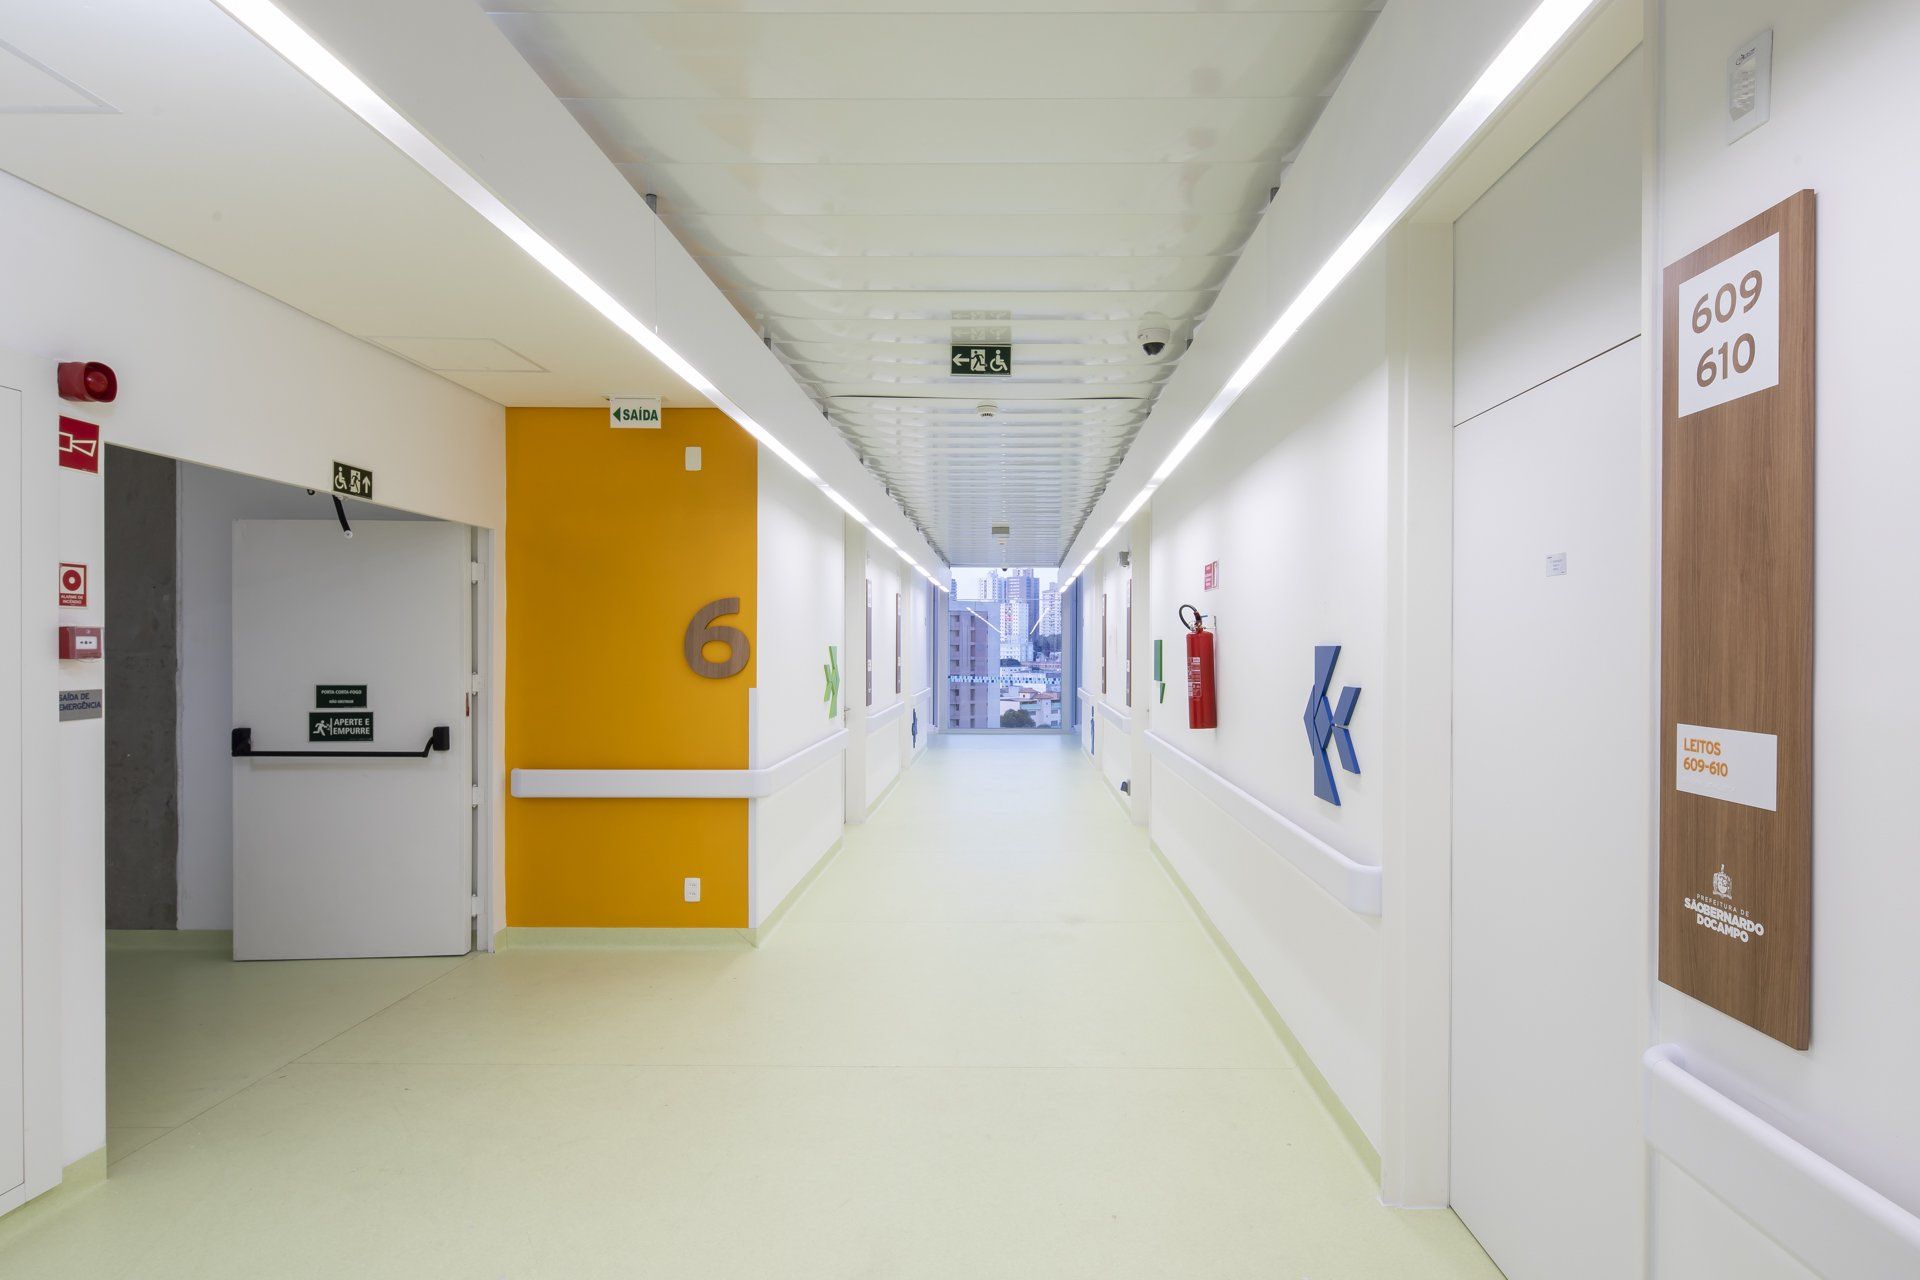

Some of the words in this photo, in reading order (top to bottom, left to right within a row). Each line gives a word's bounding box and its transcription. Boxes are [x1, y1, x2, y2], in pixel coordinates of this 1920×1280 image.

[1692, 270, 1763, 334] 609
[1696, 333, 1756, 388] 610
[622, 406, 659, 421] SAÍDA
[684, 597, 751, 679] 6
[80, 692, 90, 700] DE
[59, 701, 102, 711] EMERGÊNCIA
[333, 727, 370, 735] EMPURRE
[1683, 738, 1721, 756] LEITOS
[1683, 756, 1729, 777] 609-610
[1696, 893, 1737, 913] PREFEITURA
[1740, 909, 1750, 918] DE
